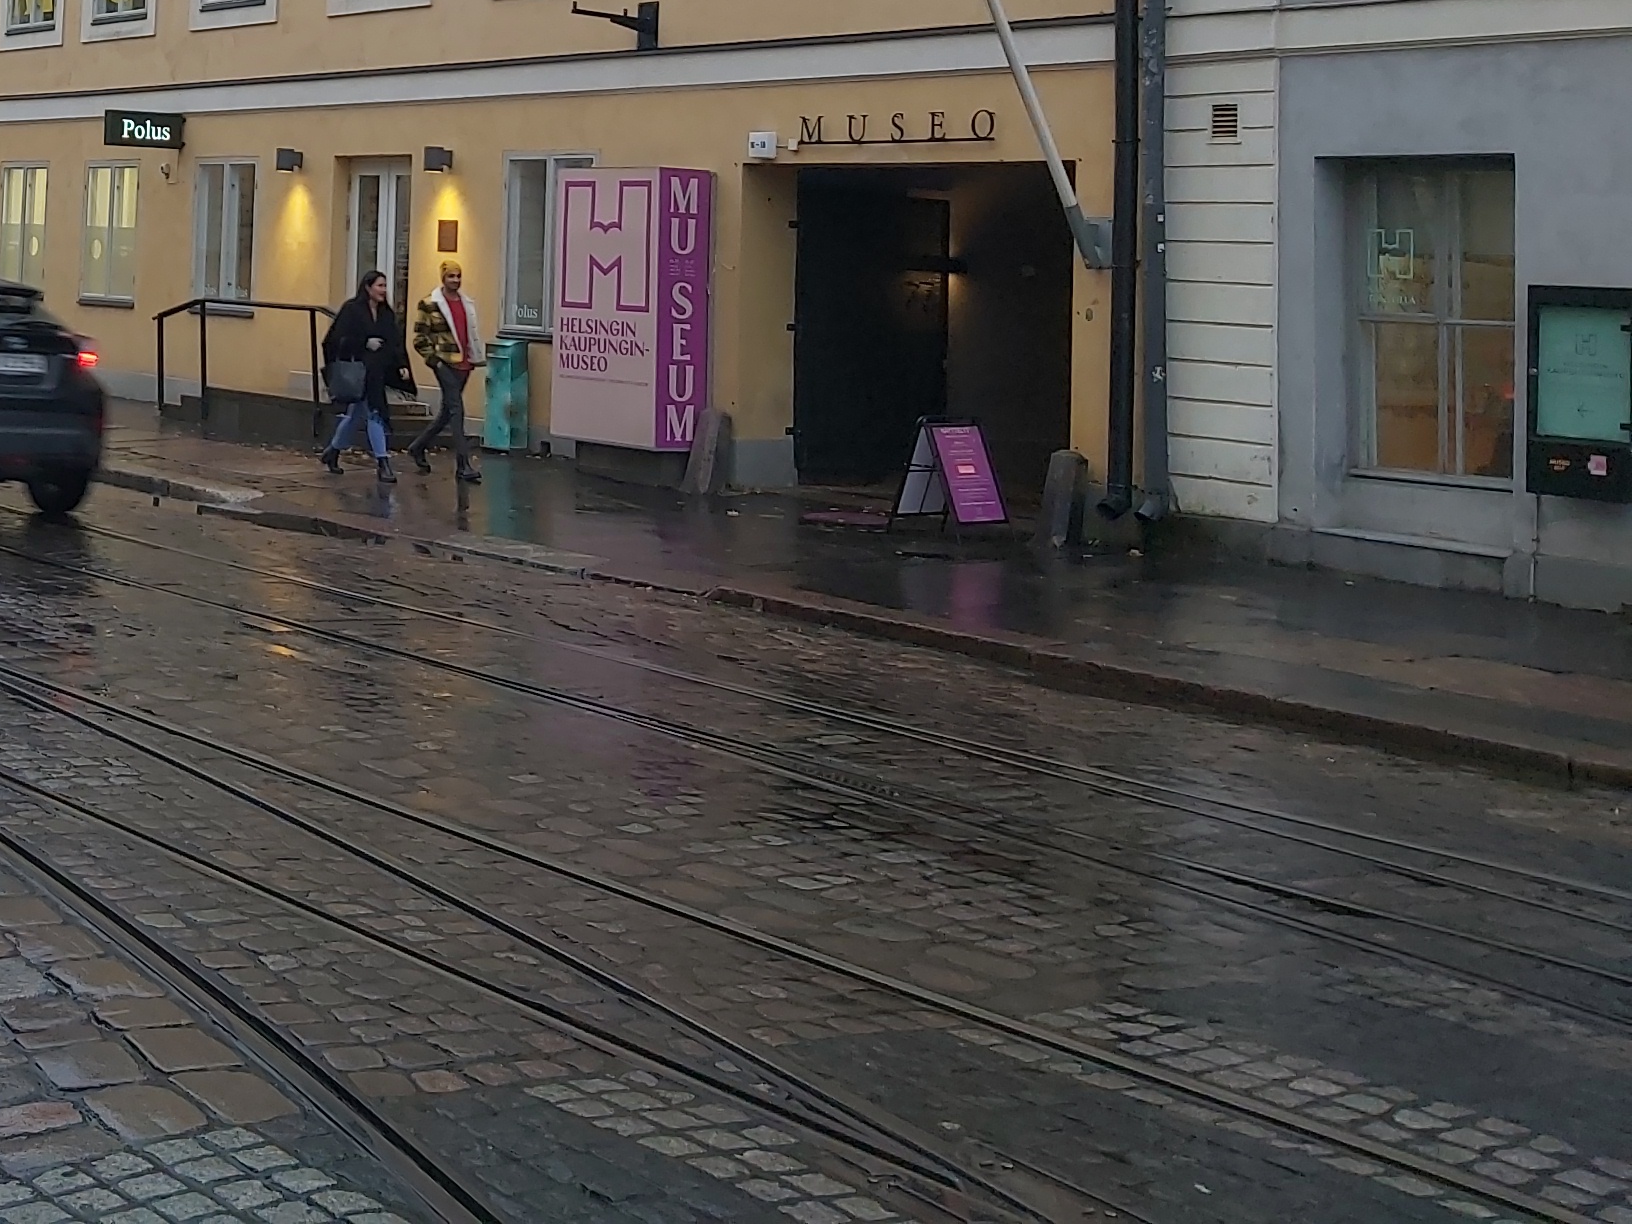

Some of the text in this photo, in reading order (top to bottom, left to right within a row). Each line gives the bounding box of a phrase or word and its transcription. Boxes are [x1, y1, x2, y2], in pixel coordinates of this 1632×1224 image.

[121, 118, 171, 141] Polus
[799, 109, 996, 143] MUSEO
[665, 175, 700, 443] MUSEUM
[559, 316, 637, 338] HELSINGIN
[558, 335, 651, 358] KAUPUNGIN-
[558, 352, 609, 373] MUSEO
